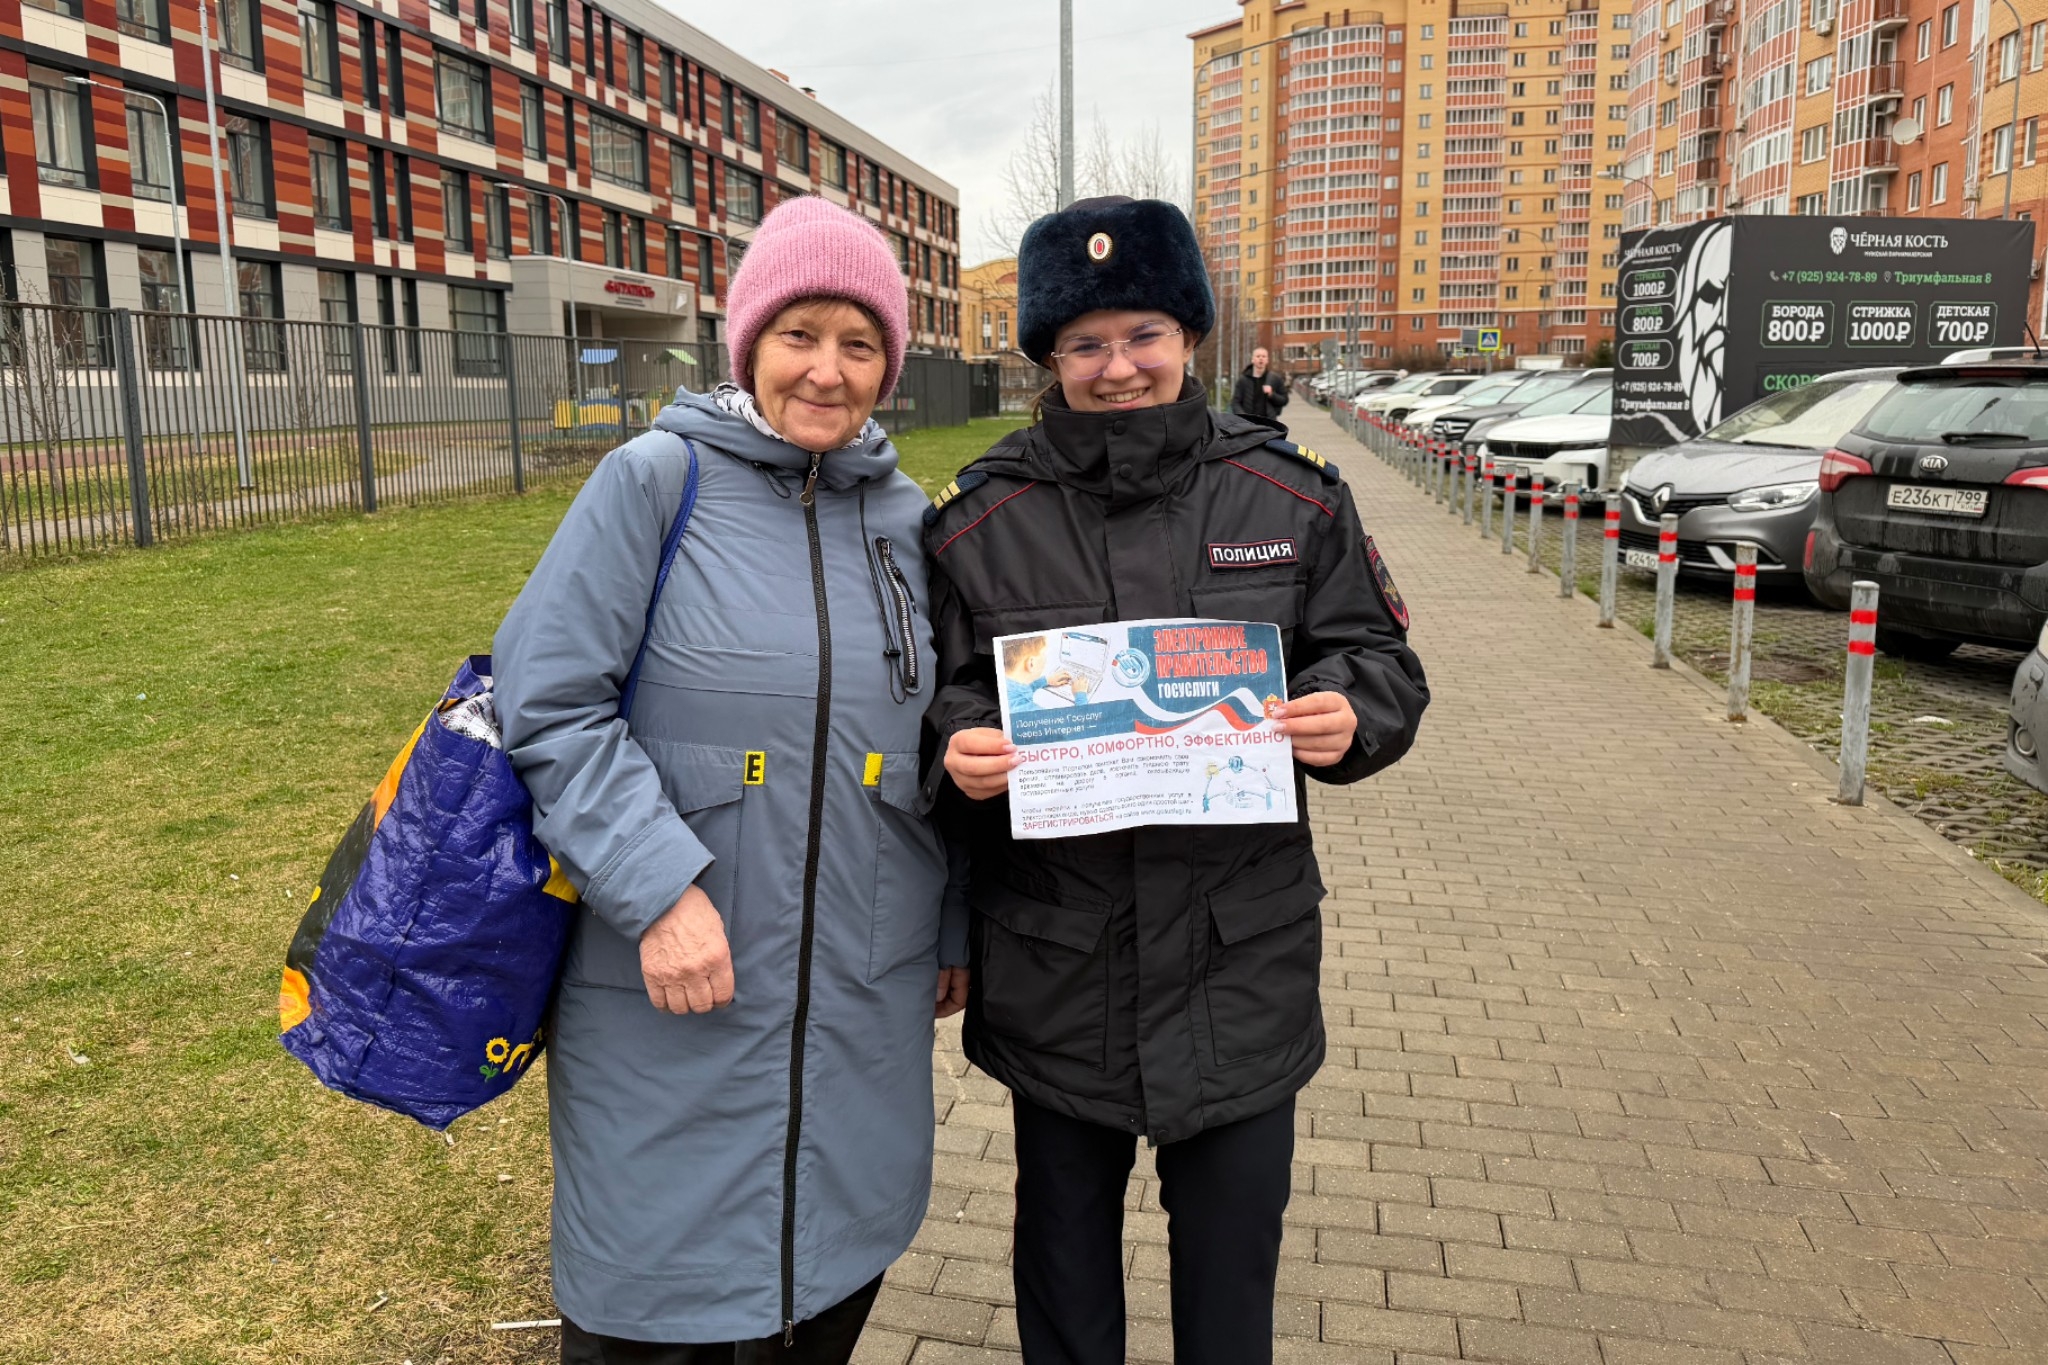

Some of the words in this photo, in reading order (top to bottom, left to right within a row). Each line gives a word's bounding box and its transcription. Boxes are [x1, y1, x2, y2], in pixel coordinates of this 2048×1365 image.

[1850, 231, 1903, 248] ЧЁРНАЯ
[1905, 234, 1949, 249] КОСТЬ
[1781, 270, 1796, 284] +7
[1797, 270, 1824, 284] (925)
[1825, 271, 1878, 283] 924-78-89
[1894, 271, 1983, 286] Триумфальная
[1984, 272, 1993, 284] 8
[1633, 281, 1666, 297] 1000₽
[1771, 305, 1824, 319] БОРОДА
[1852, 305, 1912, 319] СТРИЖКА
[1936, 305, 1990, 318] ДЕТСКАЯ
[1632, 316, 1664, 332] 800₽
[1767, 319, 1825, 342] 800₽
[1850, 321, 1911, 342] 1000₽
[1936, 320, 1989, 342] 700₽
[1631, 352, 1661, 368] 700₽
[1630, 381, 1647, 394] (925)
[1620, 398, 1682, 412] Триумфальная
[1922, 458, 1942, 469] KIA
[1892, 487, 1953, 508] Е236КТ
[1957, 490, 1982, 505] 799
[1212, 542, 1293, 562] ПОЛИЦИЯ
[1153, 625, 1247, 653] ЭЛЕКТРОННОЕ
[1155, 648, 1268, 679] ПРАВИТЕЛЬСТВО
[1157, 681, 1220, 699] ГОСУСЛУГИ
[1016, 717, 1064, 729] Получение
[1066, 711, 1103, 723] Госуслуг
[1016, 729, 1043, 738] через
[1018, 746, 1084, 763] БЫСТРО,
[1087, 735, 1179, 756] КОМФОРТНО,
[1183, 730, 1285, 747] ЭФФЕКТИВНО
[1022, 812, 1114, 831] ЗАРЕГИСТРИРОВАТЬСЯ
